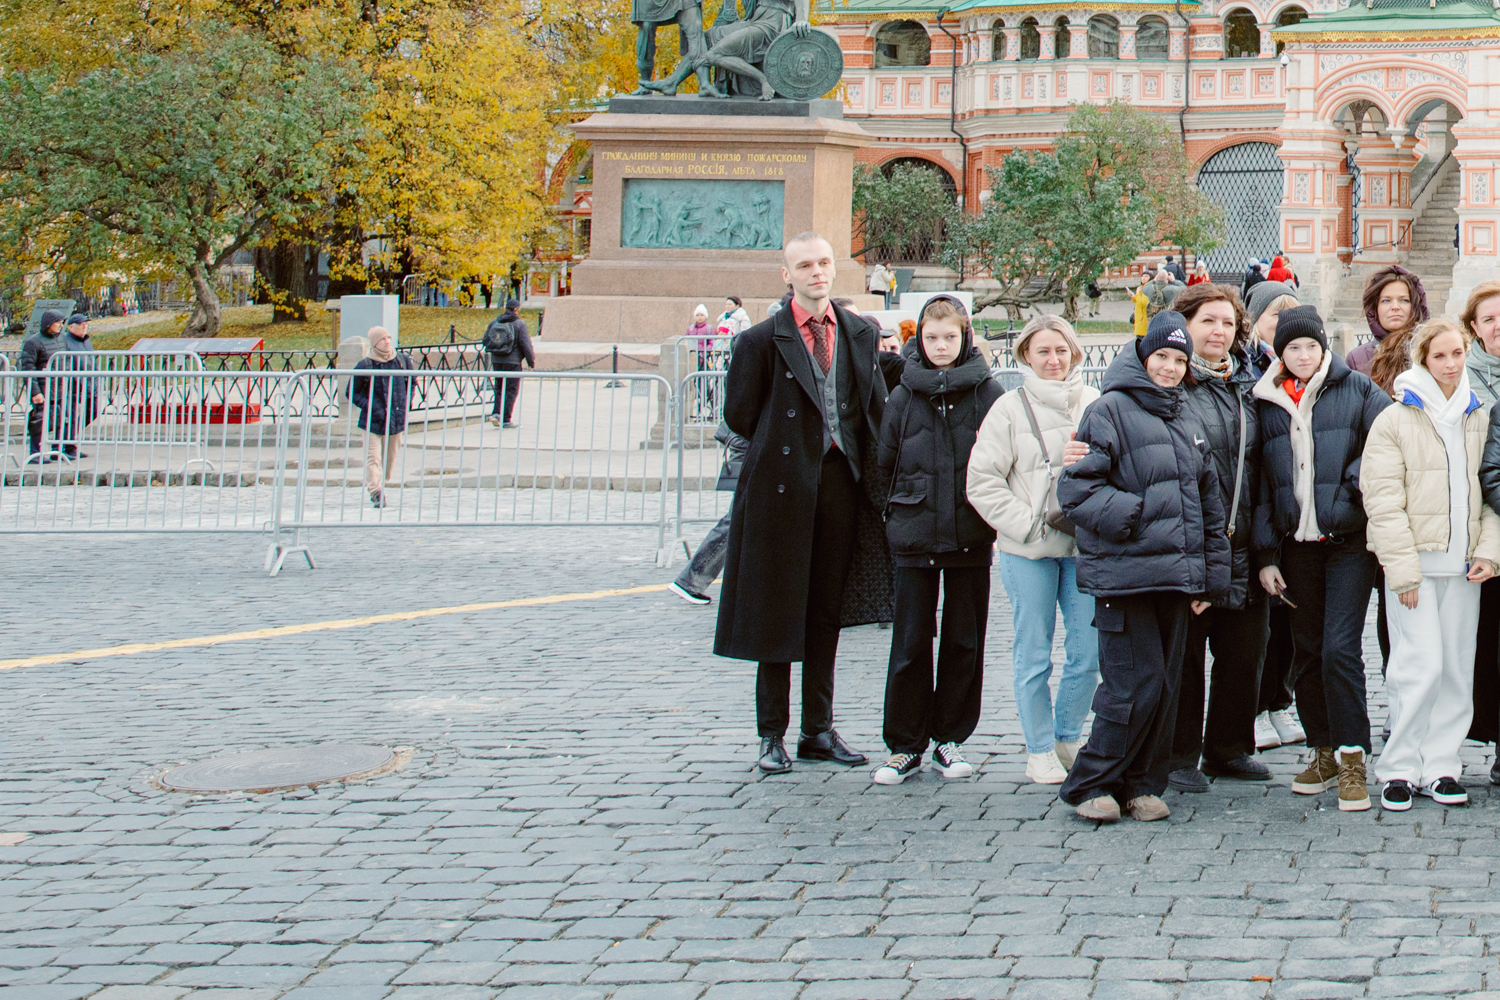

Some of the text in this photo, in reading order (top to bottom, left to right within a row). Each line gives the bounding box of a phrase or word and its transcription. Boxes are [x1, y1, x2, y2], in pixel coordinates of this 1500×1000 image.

[601, 151, 807, 163] ГРАЖДАНИНУ МИНИНУ И КНЯЗЮ ПОЖАРСКОМУ
[625, 165, 684, 174] БЛАГОДАРНАЯ
[764, 167, 784, 176] 1818
[1167, 335, 1187, 344] adidas
